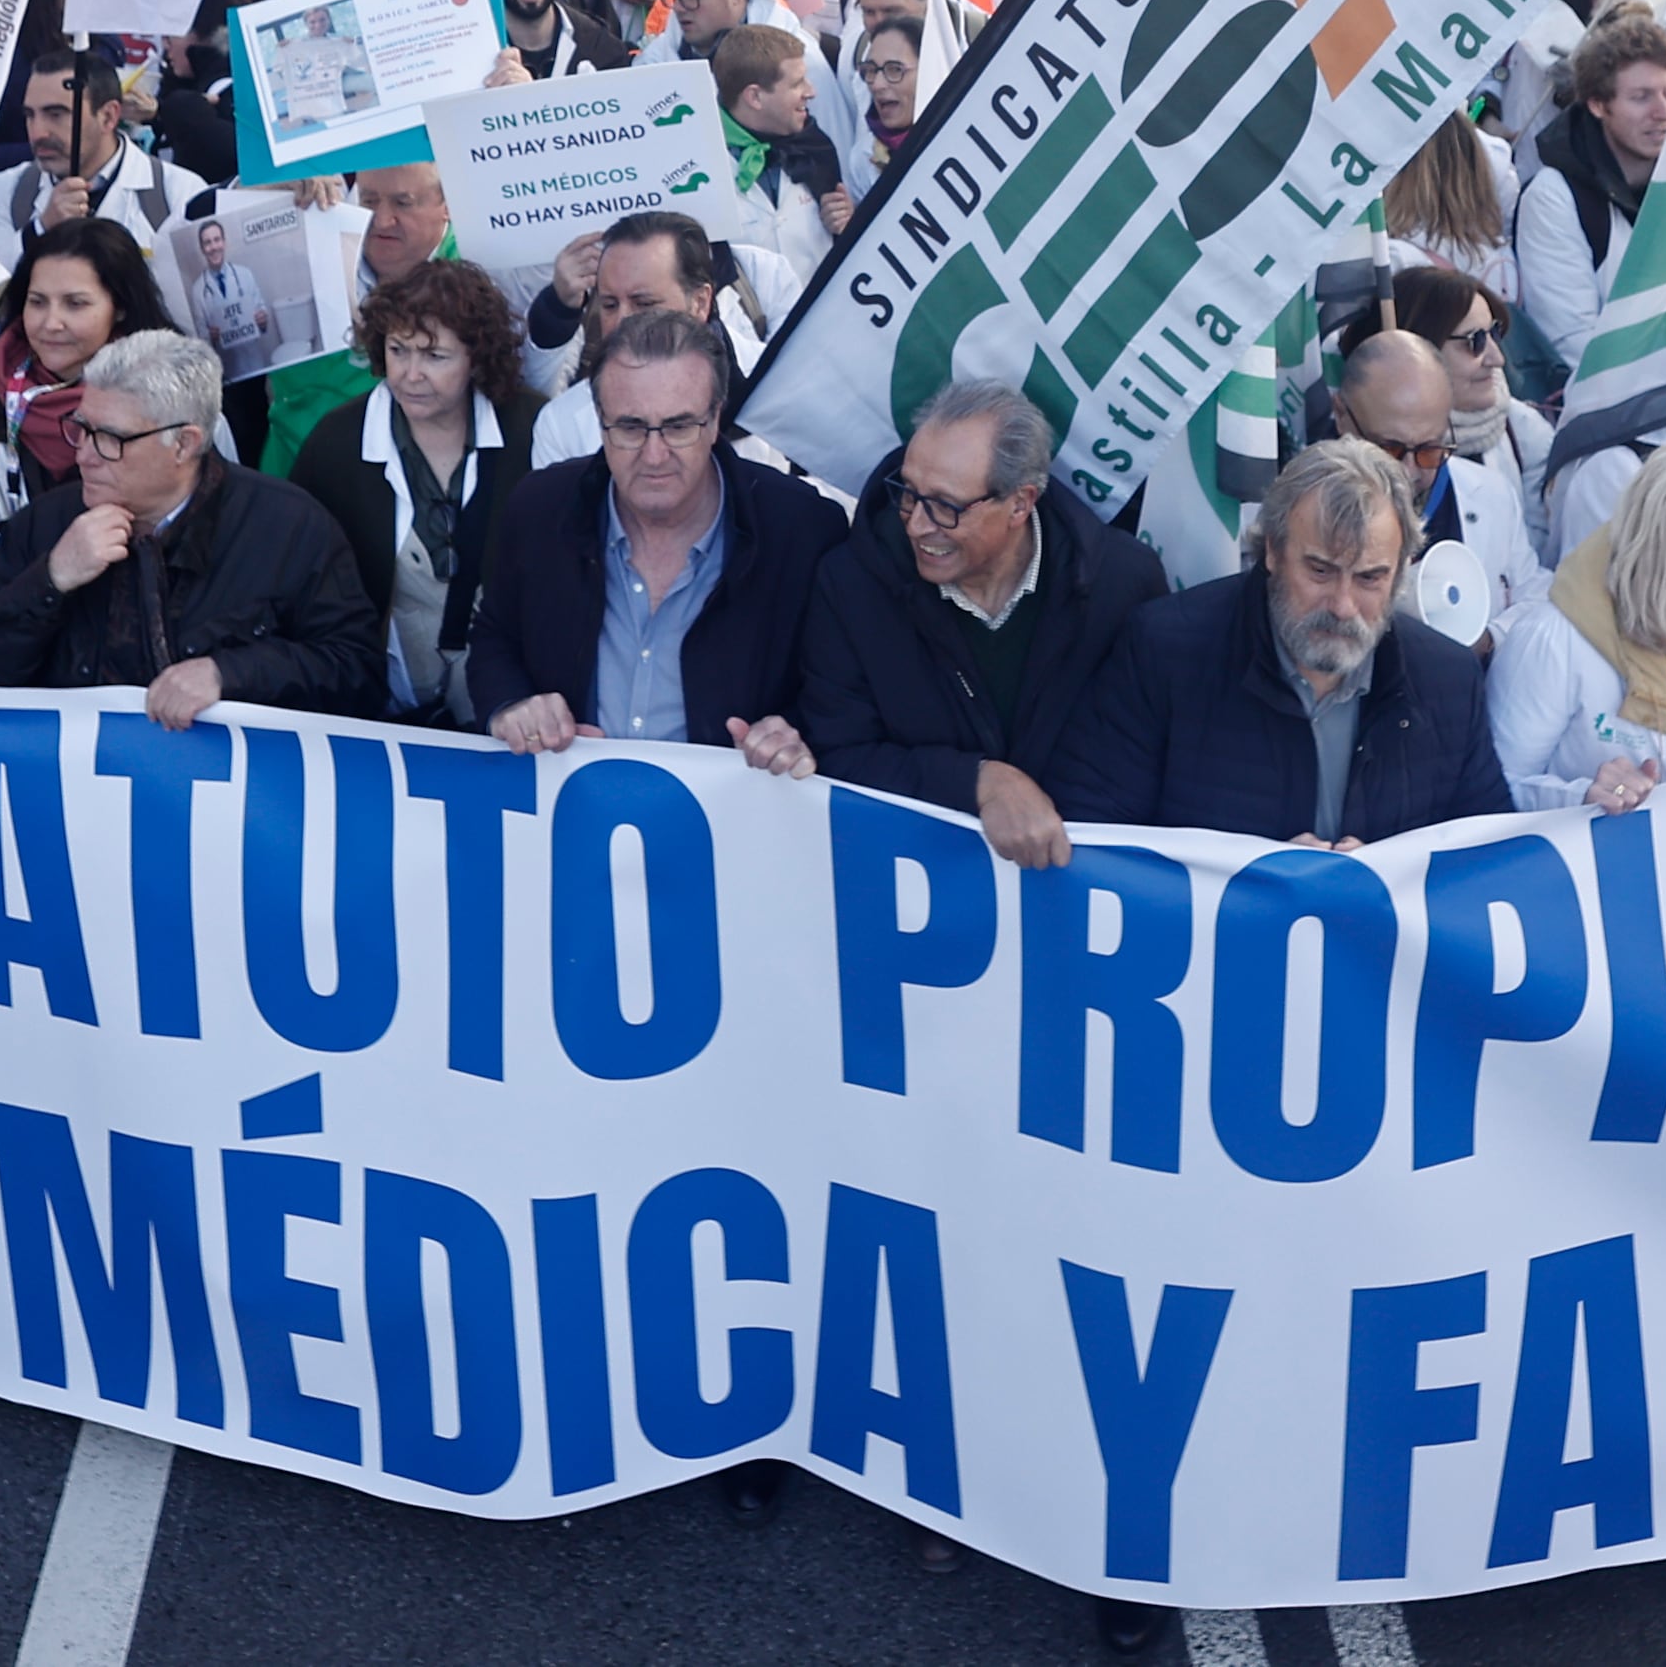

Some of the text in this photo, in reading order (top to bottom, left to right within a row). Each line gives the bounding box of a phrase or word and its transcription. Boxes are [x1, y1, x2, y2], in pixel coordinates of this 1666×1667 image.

[482, 90, 682, 132] SIN MÉDICOS simex
[470, 123, 646, 163] NO HAY SANIDAD
[501, 158, 698, 200] SIN MÉDICOS simex
[244, 210, 297, 237] SANITARIOS
[490, 191, 662, 230] NO HAY SANIDAD
[223, 302, 243, 320] JEFE
[1070, 299, 1241, 506] astilla
[1280, 138, 1377, 230] La
[1059, 1257, 1235, 1584] Y
